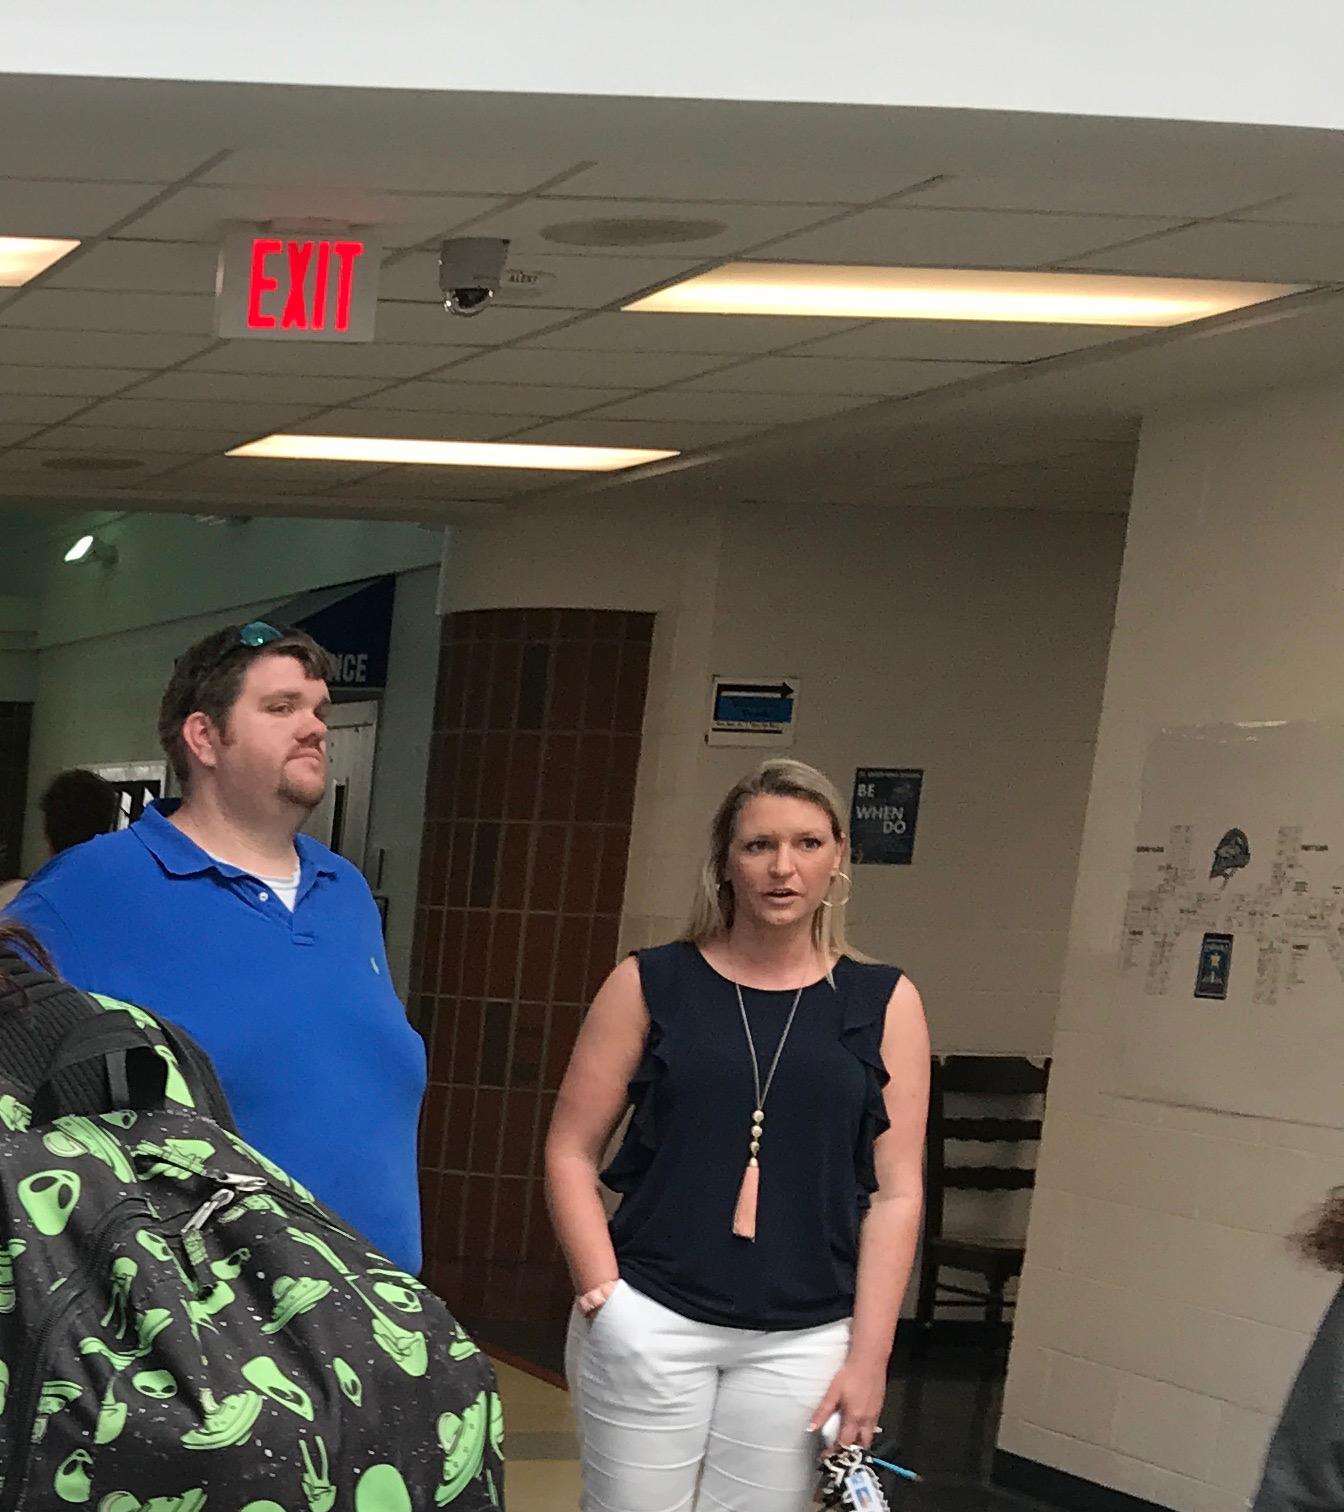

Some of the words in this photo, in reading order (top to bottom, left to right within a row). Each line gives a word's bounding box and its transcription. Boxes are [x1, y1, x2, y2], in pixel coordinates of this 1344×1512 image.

[247, 239, 364, 333] EXIT
[857, 783, 875, 798] BE
[856, 803, 904, 820] WHEN
[883, 820, 907, 835] DO
